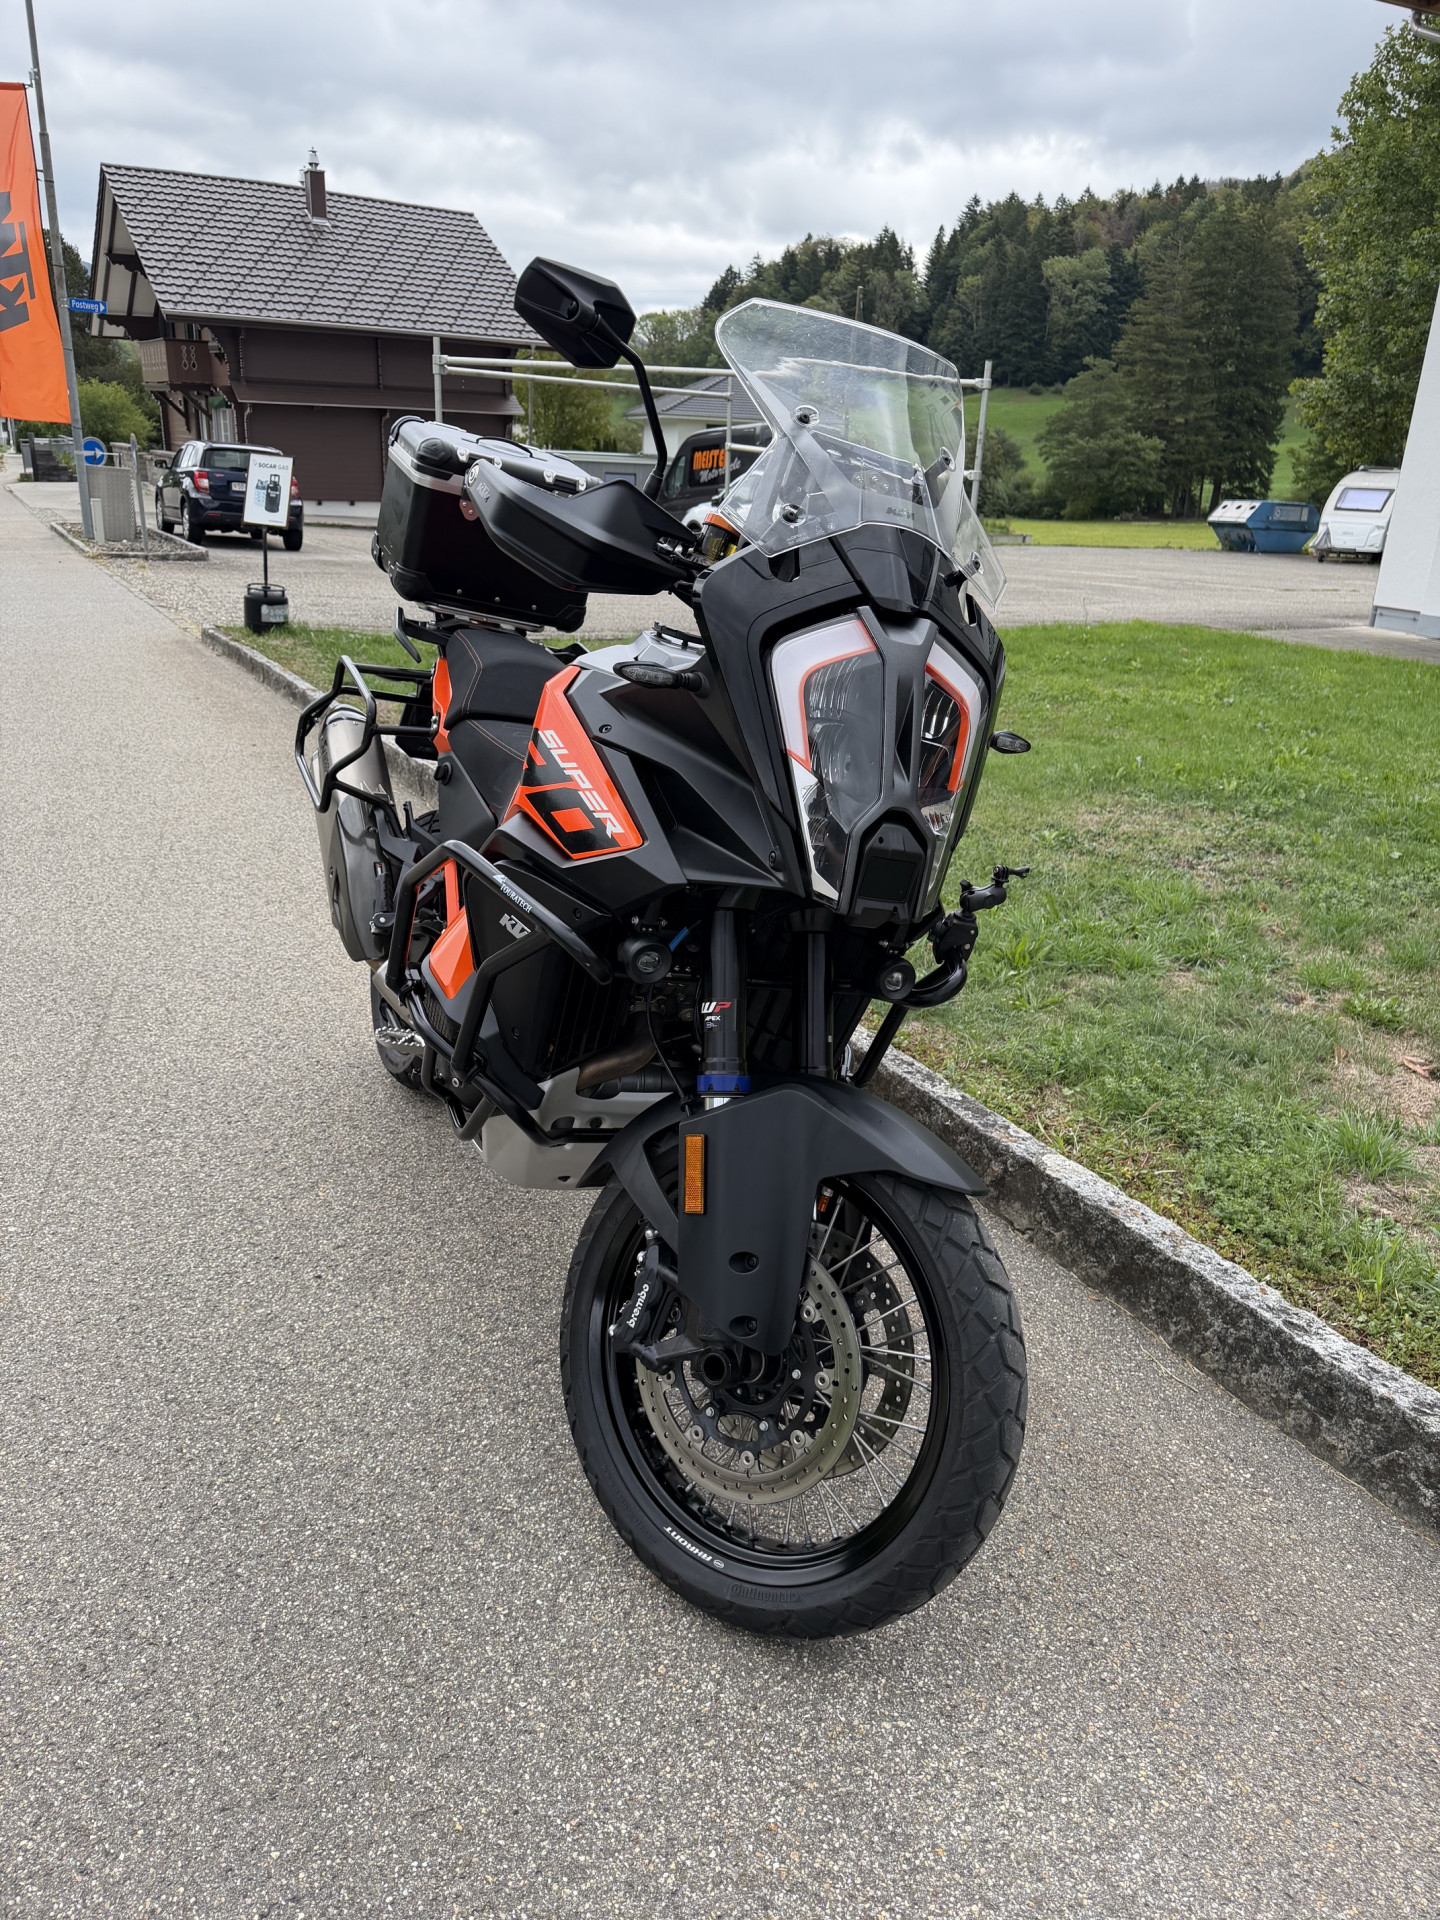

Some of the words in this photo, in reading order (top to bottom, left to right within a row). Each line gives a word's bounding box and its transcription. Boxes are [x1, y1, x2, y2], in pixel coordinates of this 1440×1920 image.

[71, 300, 99, 313] Postweg
[258, 462, 277, 470] SOCAR
[693, 449, 727, 470] MEISTE
[538, 729, 625, 839] SUPER
[500, 883, 533, 914] TOURATECH
[701, 1001, 732, 1014] WP
[626, 1283, 650, 1329] brembo
